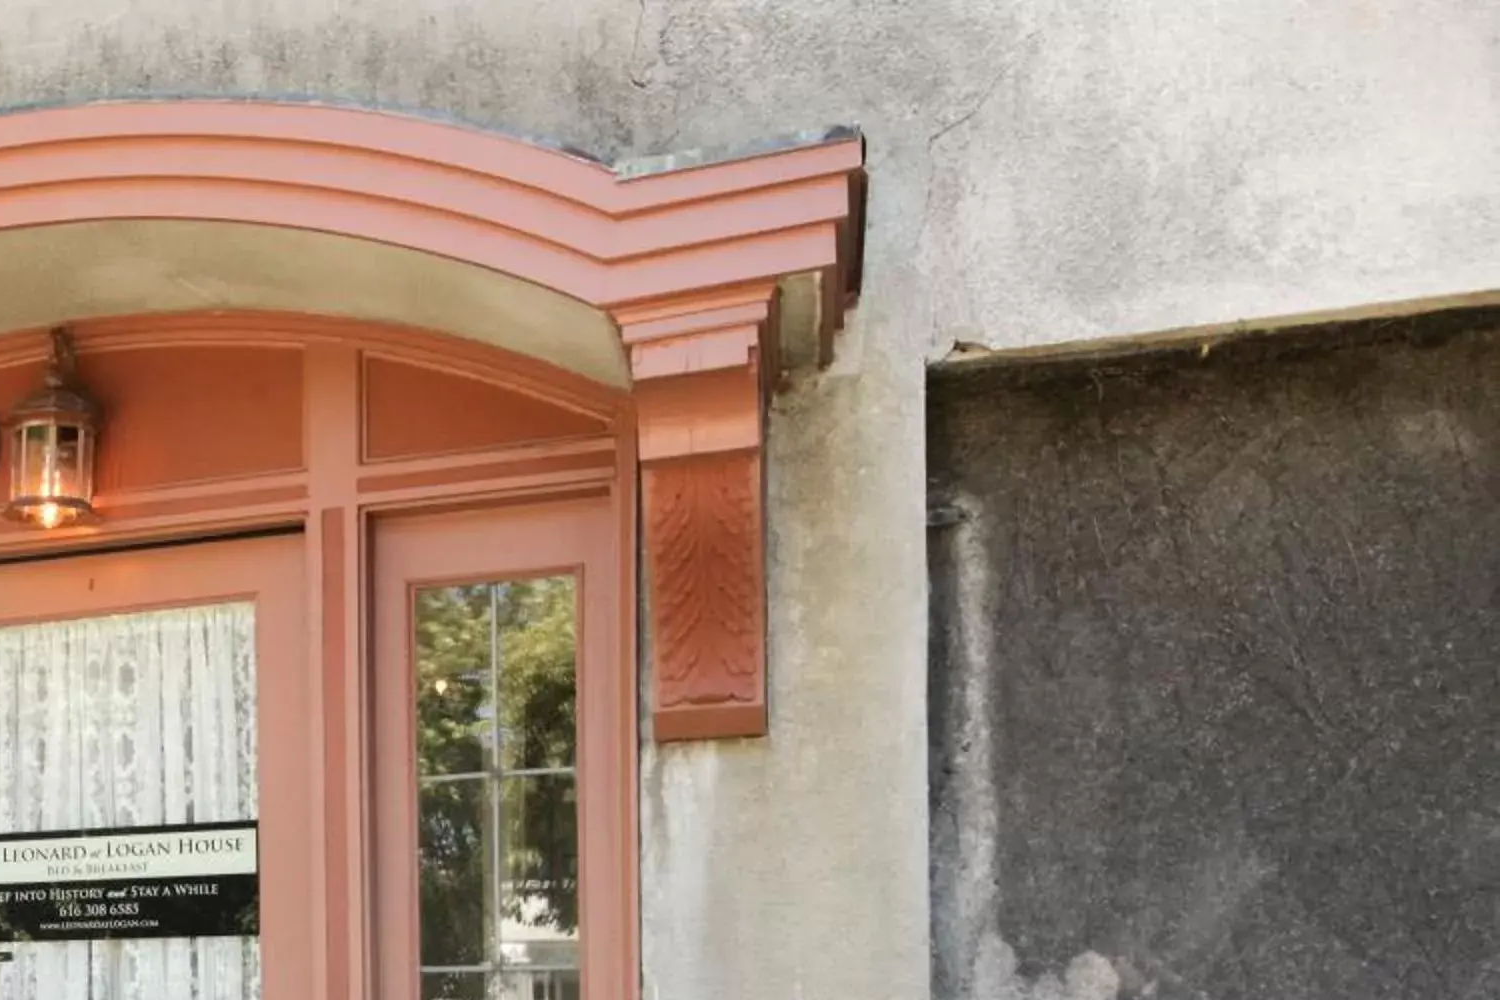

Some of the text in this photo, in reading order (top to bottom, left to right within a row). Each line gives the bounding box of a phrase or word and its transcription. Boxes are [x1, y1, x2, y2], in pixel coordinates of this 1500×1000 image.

[3, 845, 87, 863] LEONARD
[107, 840, 171, 858] LOGAN
[179, 837, 245, 855] HOUSE
[47, 865, 70, 877] BED
[15, 889, 47, 902] INTO
[50, 887, 106, 901] HISTORY
[107, 887, 127, 899] and
[131, 885, 160, 898] STAY
[162, 886, 171, 897] A
[174, 883, 220, 896] WHILE
[59, 904, 82, 918] 616
